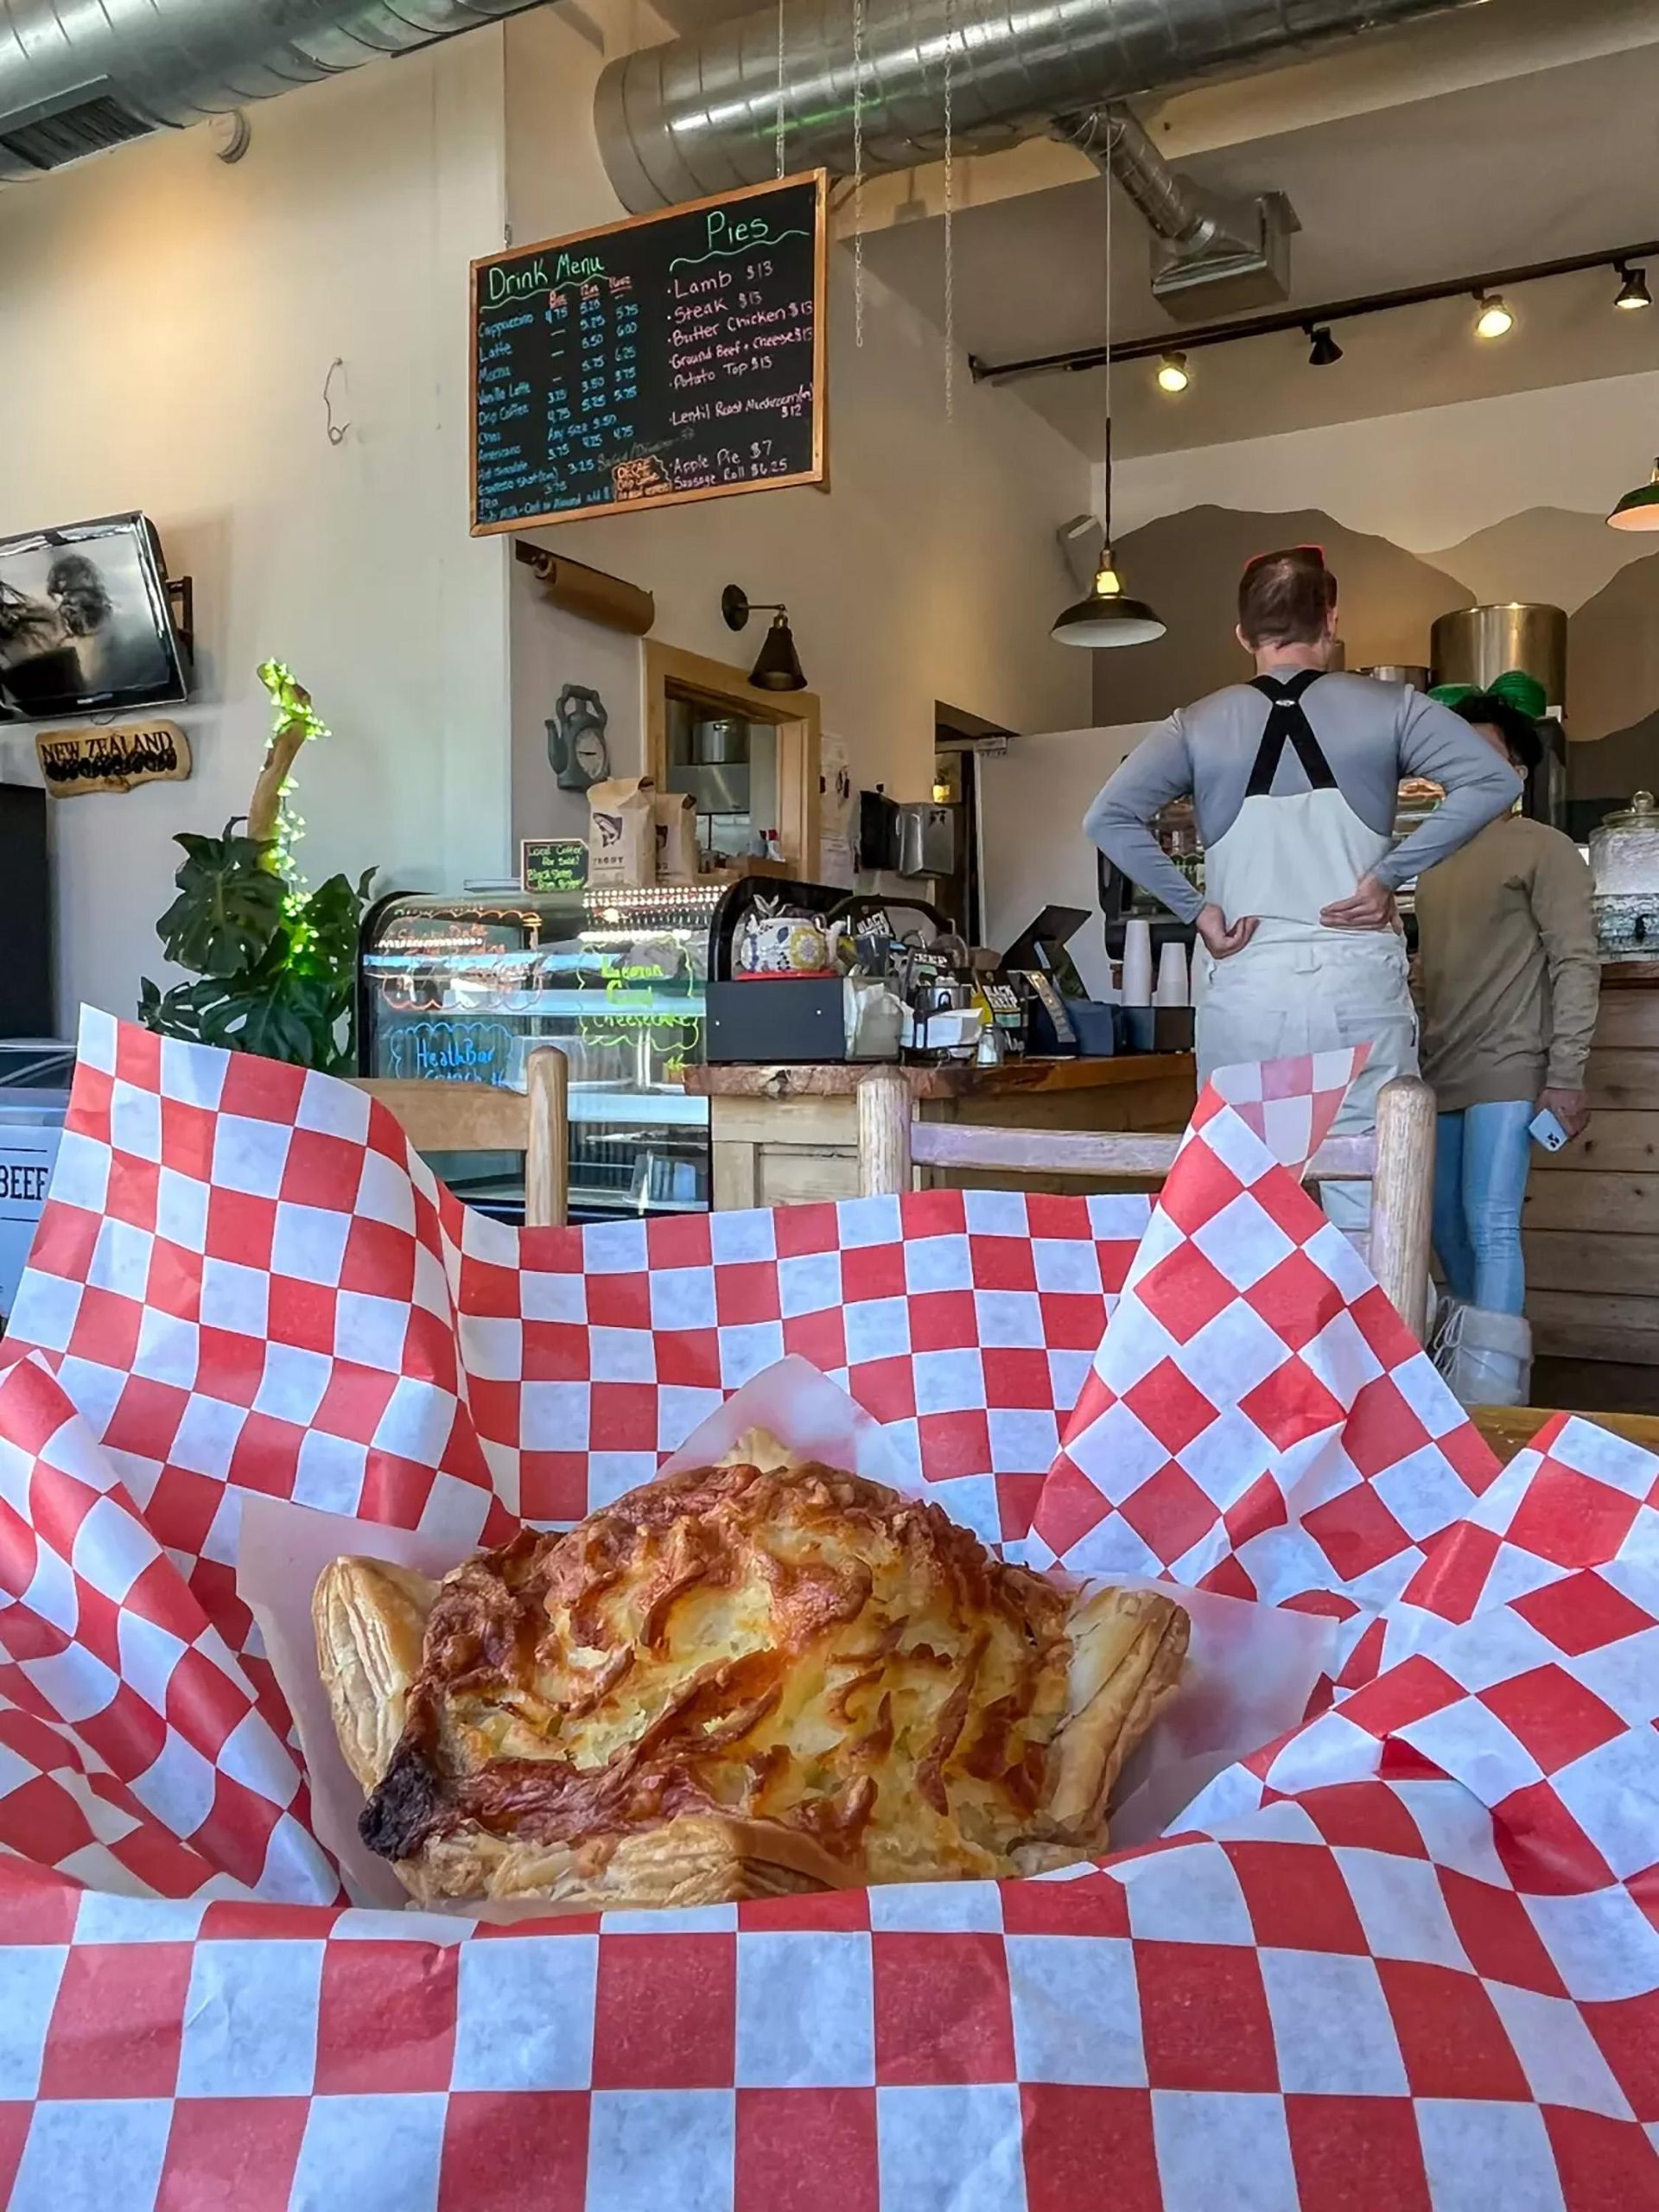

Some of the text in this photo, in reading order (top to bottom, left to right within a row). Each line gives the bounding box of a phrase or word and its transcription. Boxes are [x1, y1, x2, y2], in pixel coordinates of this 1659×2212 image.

[707, 210, 769, 249] Pies
[489, 253, 606, 300] Drink Menu
[674, 261, 773, 299] Lamb $13
[674, 298, 728, 324] Steak
[672, 324, 720, 346] Butter
[727, 308, 785, 332] Chicken
[479, 341, 512, 363] Latte
[671, 347, 713, 369] Ground
[716, 340, 741, 358] Beef
[674, 369, 715, 389] Potato
[722, 362, 748, 377] Top
[672, 404, 710, 426] Lentil
[781, 405, 803, 418] $12
[674, 454, 709, 474] Apple
[716, 448, 741, 466] Pie
[750, 439, 772, 459] $7
[674, 474, 716, 489] Sausage
[724, 467, 745, 480] Roll
[41, 731, 174, 764] NEW ZEALAND
[0, 1166, 48, 1200] BEEF
